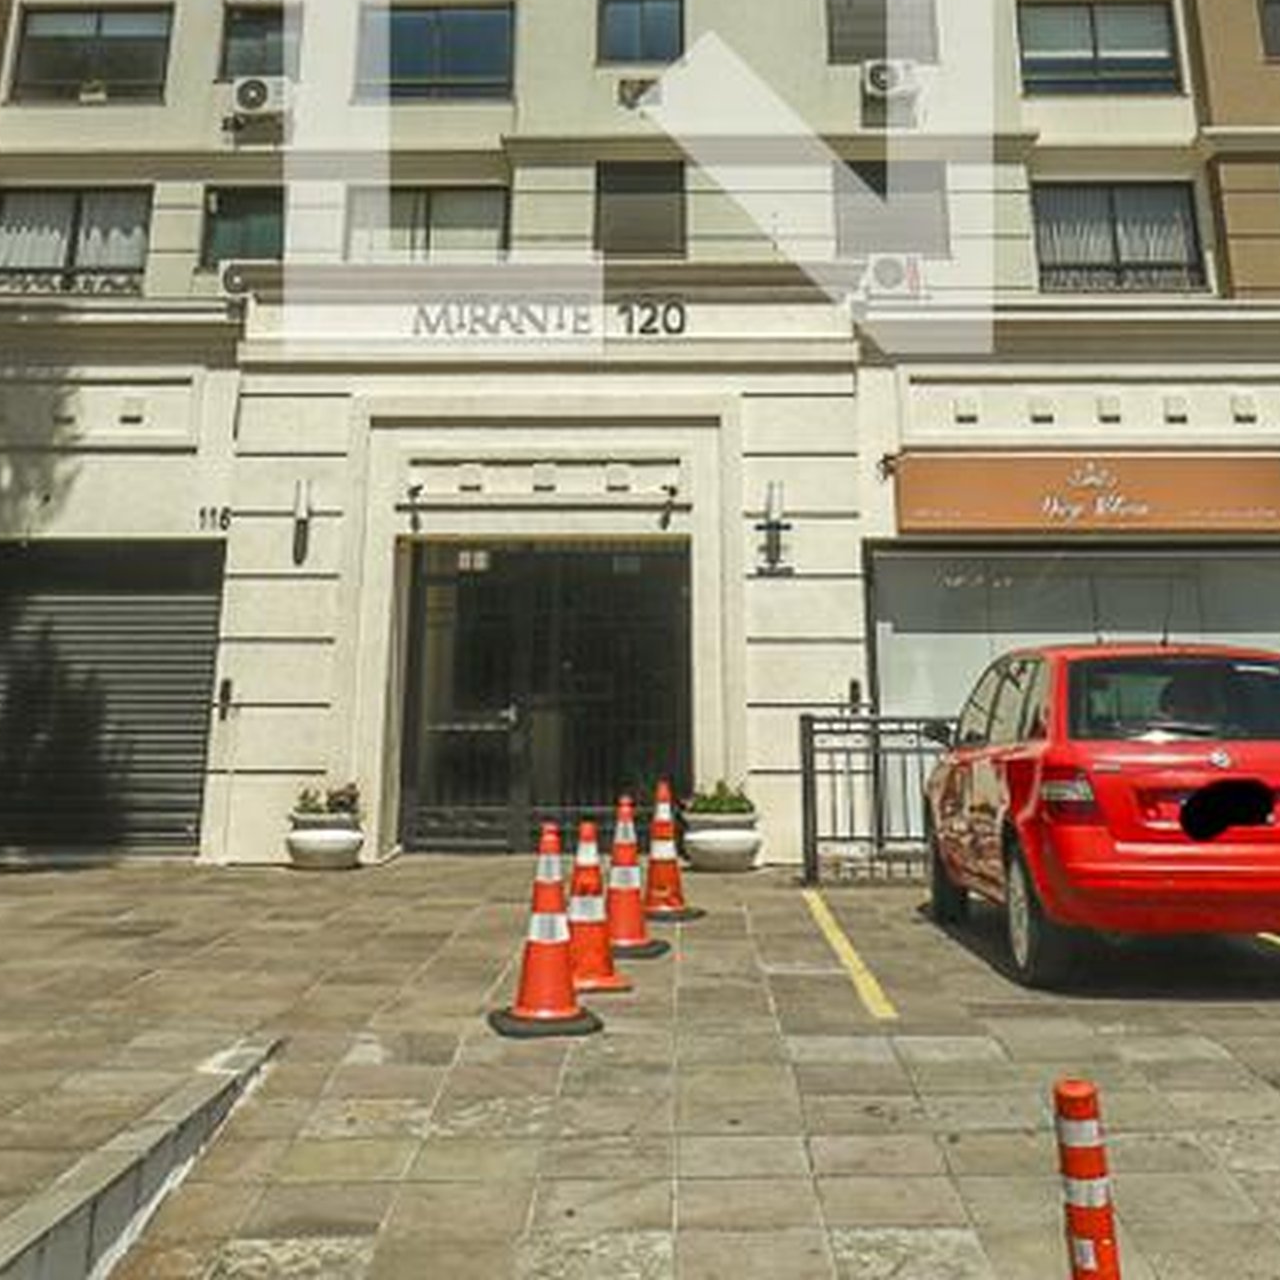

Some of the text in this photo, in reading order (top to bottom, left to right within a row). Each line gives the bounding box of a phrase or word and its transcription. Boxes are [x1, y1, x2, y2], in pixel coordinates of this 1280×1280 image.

[411, 298, 687, 335] MIRANTE 120
[199, 506, 231, 532] 116
